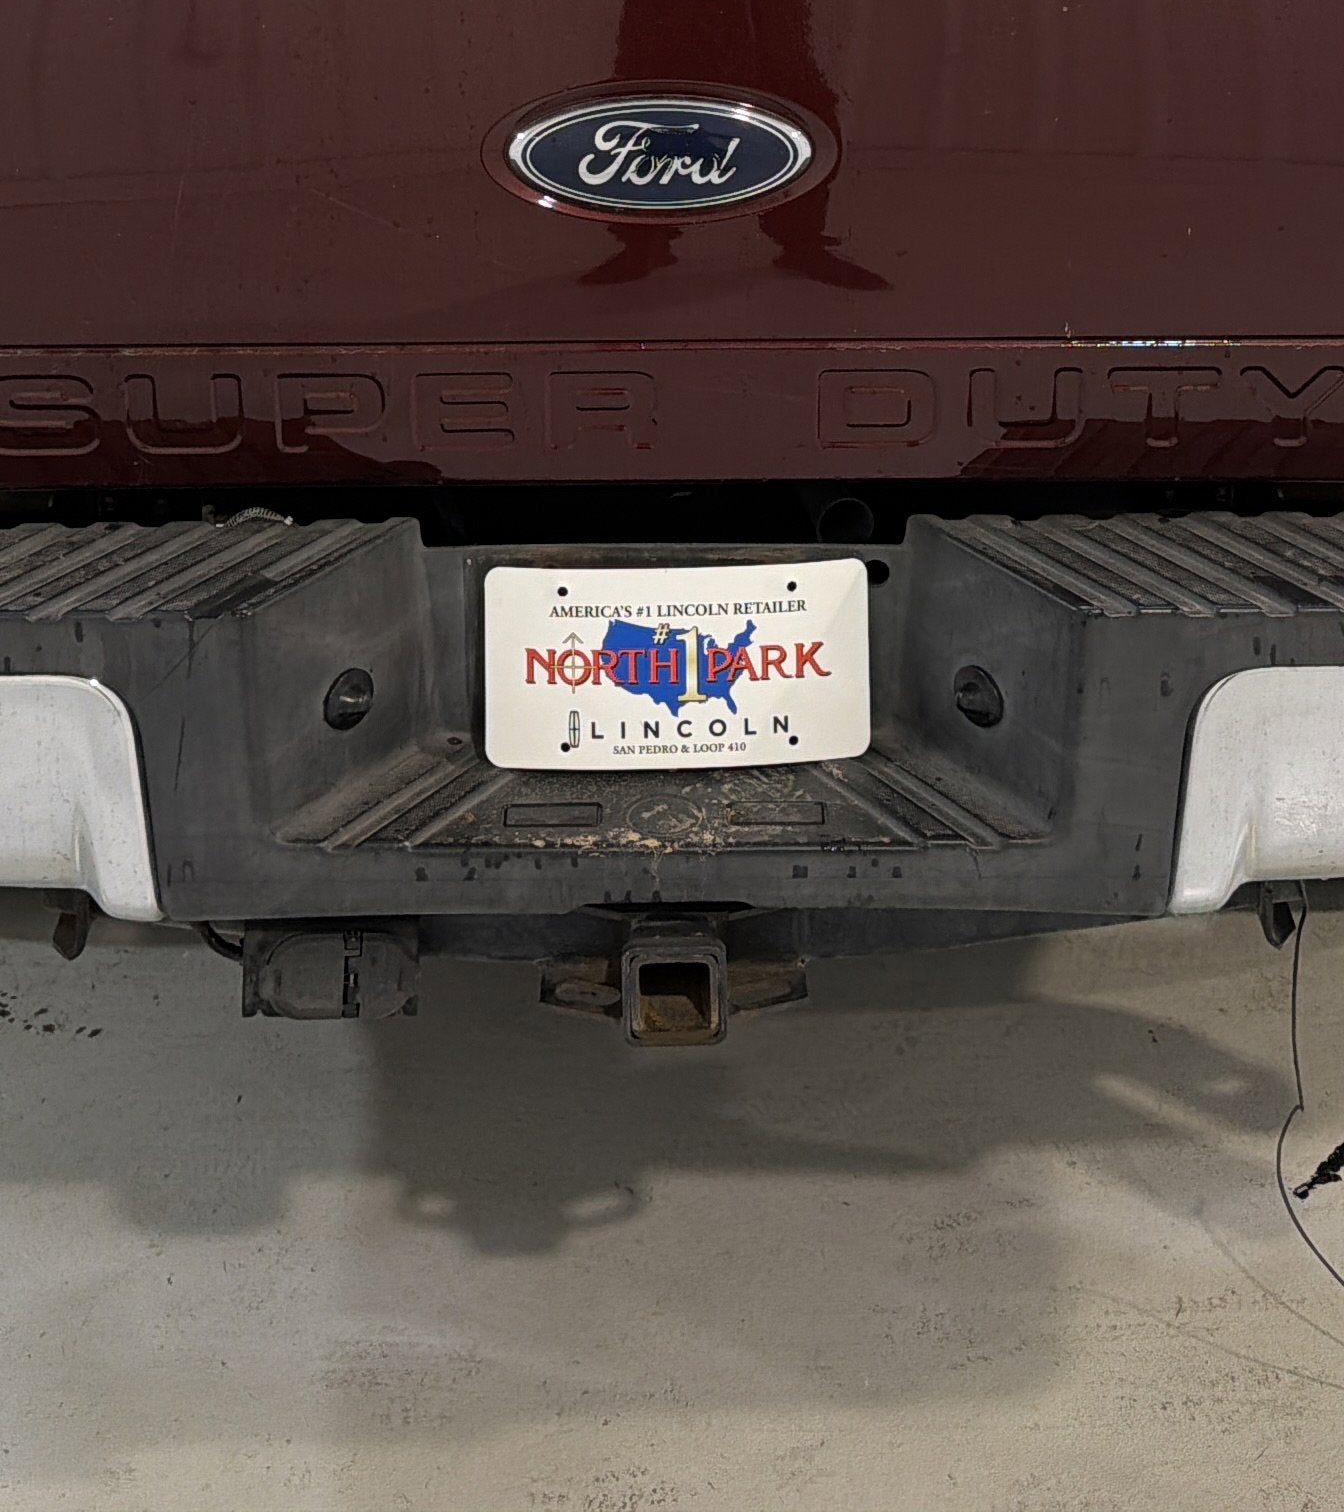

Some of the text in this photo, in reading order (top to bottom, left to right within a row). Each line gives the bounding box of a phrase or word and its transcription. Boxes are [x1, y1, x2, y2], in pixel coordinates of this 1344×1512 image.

[578, 120, 741, 186] Ford
[548, 599, 808, 619] AMERICA'S #1 LINCOLN RETAILER
[524, 640, 833, 687] NORTH PARK
[591, 715, 790, 740] LINCOLN
[612, 741, 748, 756] SAN PEDRO & LOOP 410
